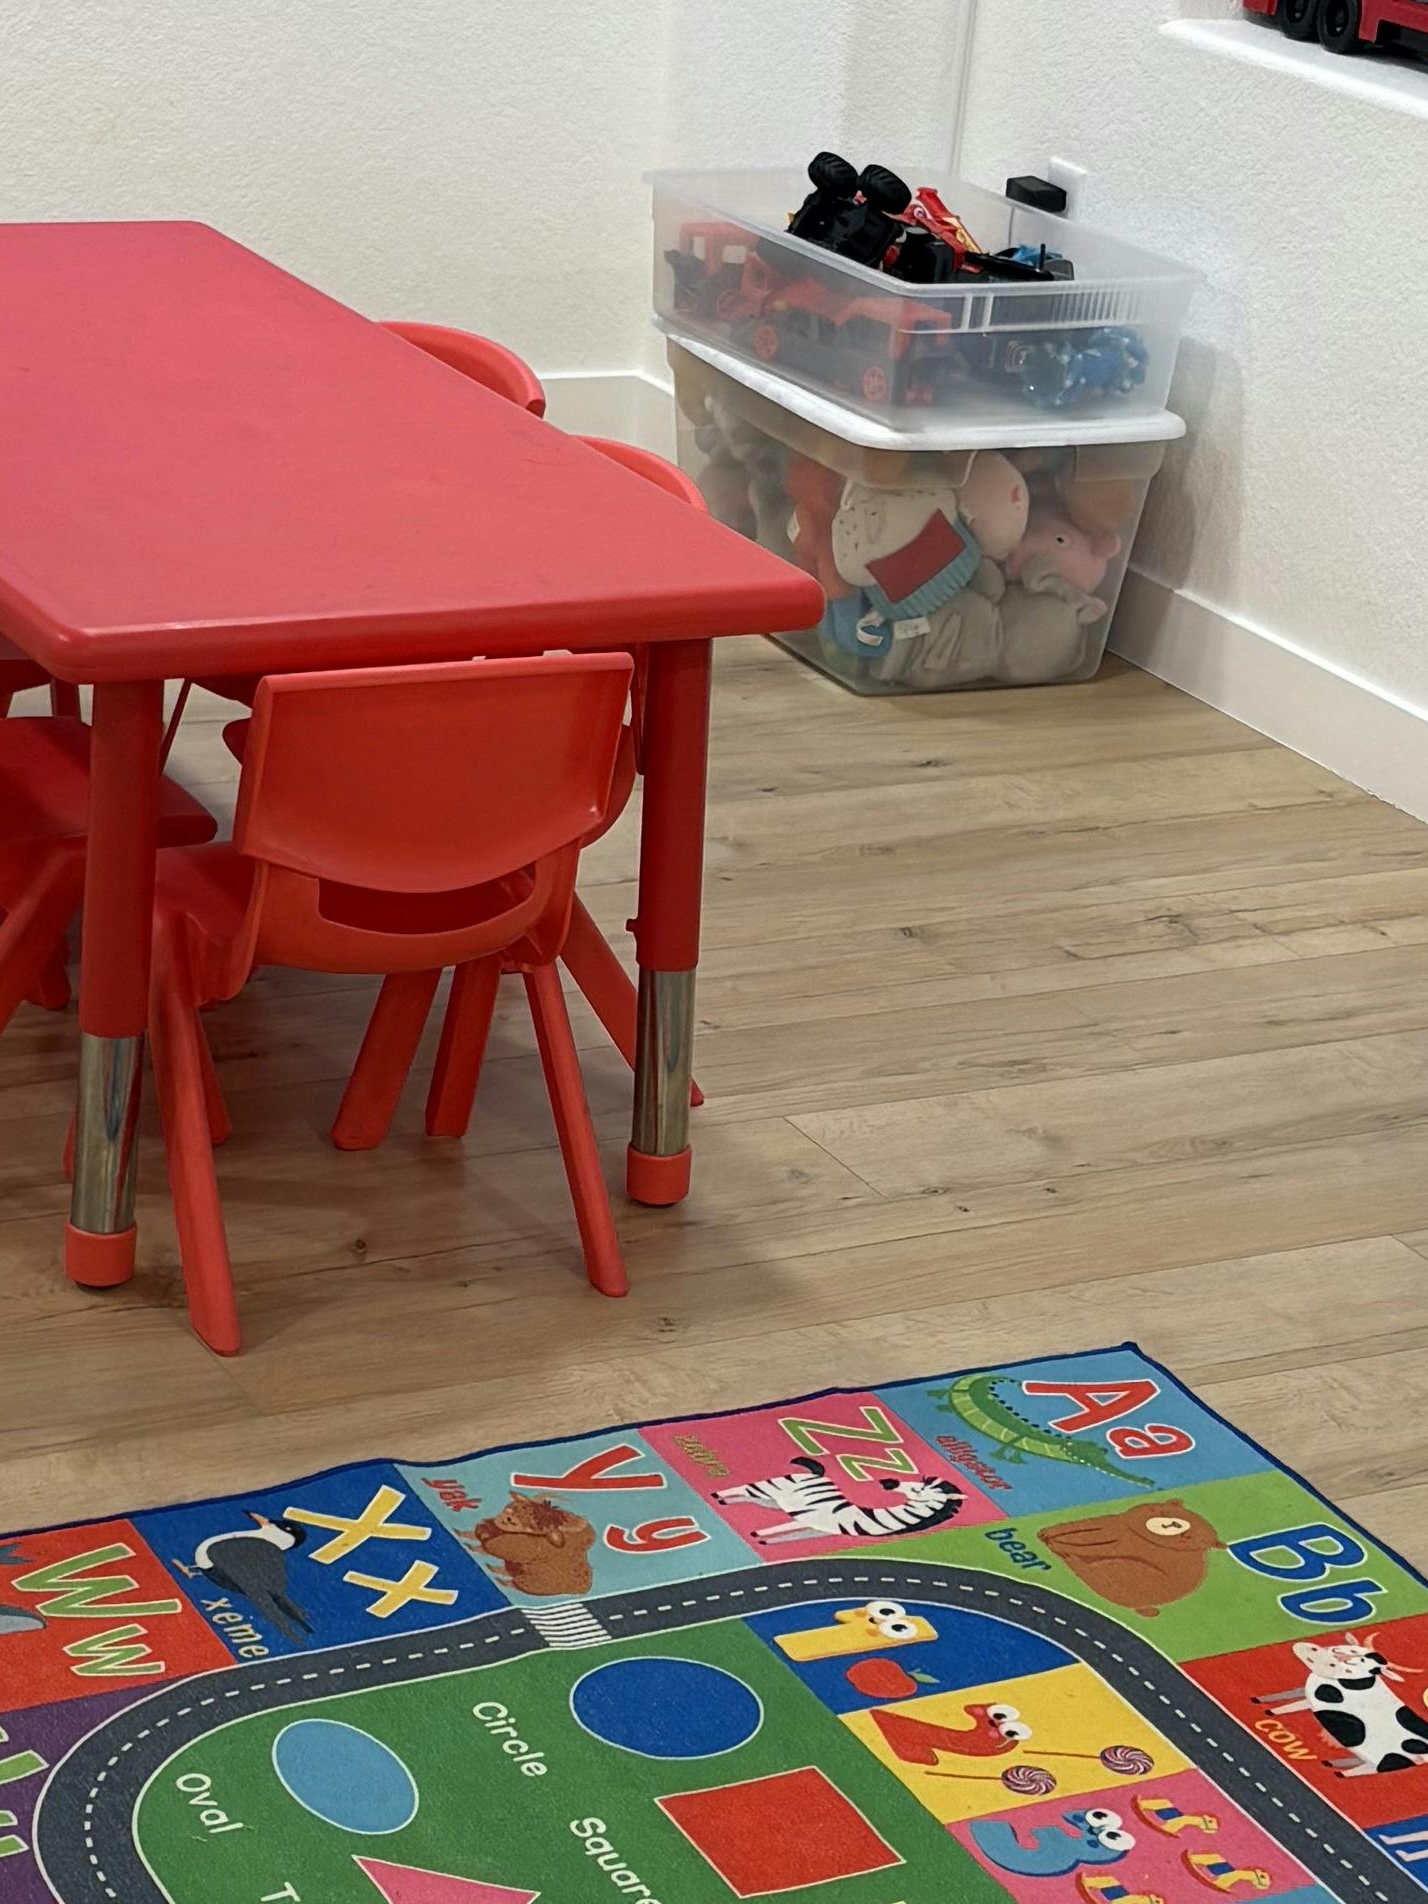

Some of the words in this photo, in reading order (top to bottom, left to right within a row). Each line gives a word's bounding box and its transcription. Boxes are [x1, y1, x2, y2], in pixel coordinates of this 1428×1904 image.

[1022, 1378, 1196, 1462] Aa
[984, 1528, 1052, 1575] bear
[471, 1701, 549, 1779] Circle
[1253, 1717, 1320, 1762] cow
[174, 1773, 244, 1835] Oval
